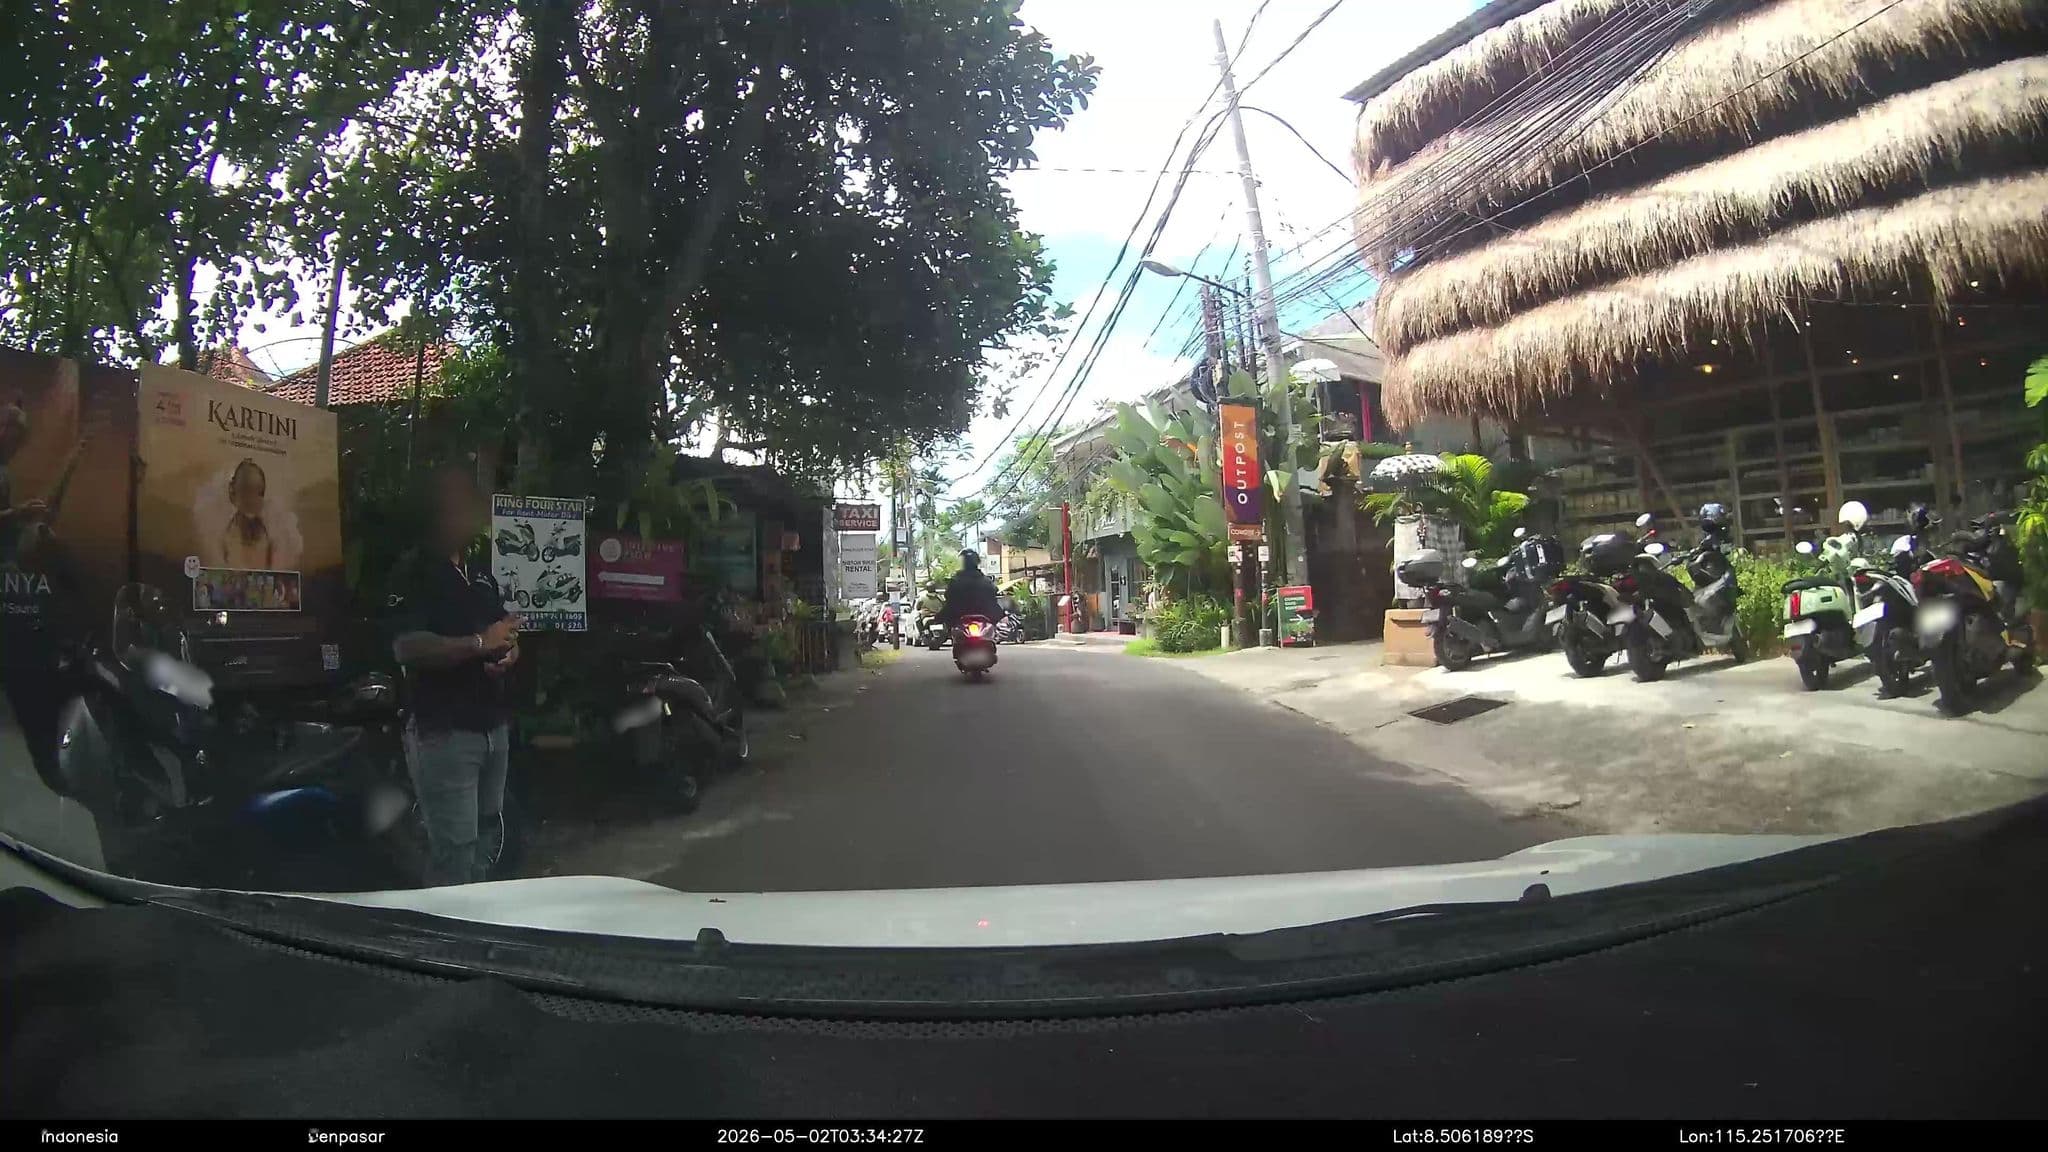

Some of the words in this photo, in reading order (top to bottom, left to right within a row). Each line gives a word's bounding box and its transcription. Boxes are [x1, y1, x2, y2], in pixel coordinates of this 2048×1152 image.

[207, 399, 297, 440] KARTINI
[1233, 421, 1248, 504] OUTPOST
[496, 496, 523, 508] KING
[525, 499, 554, 510] FOUR
[555, 500, 582, 512] STAR
[840, 507, 878, 519] TAXI
[839, 519, 878, 528] SERVICE
[845, 565, 872, 573] RENTAL
[0, 572, 52, 594] NYA
